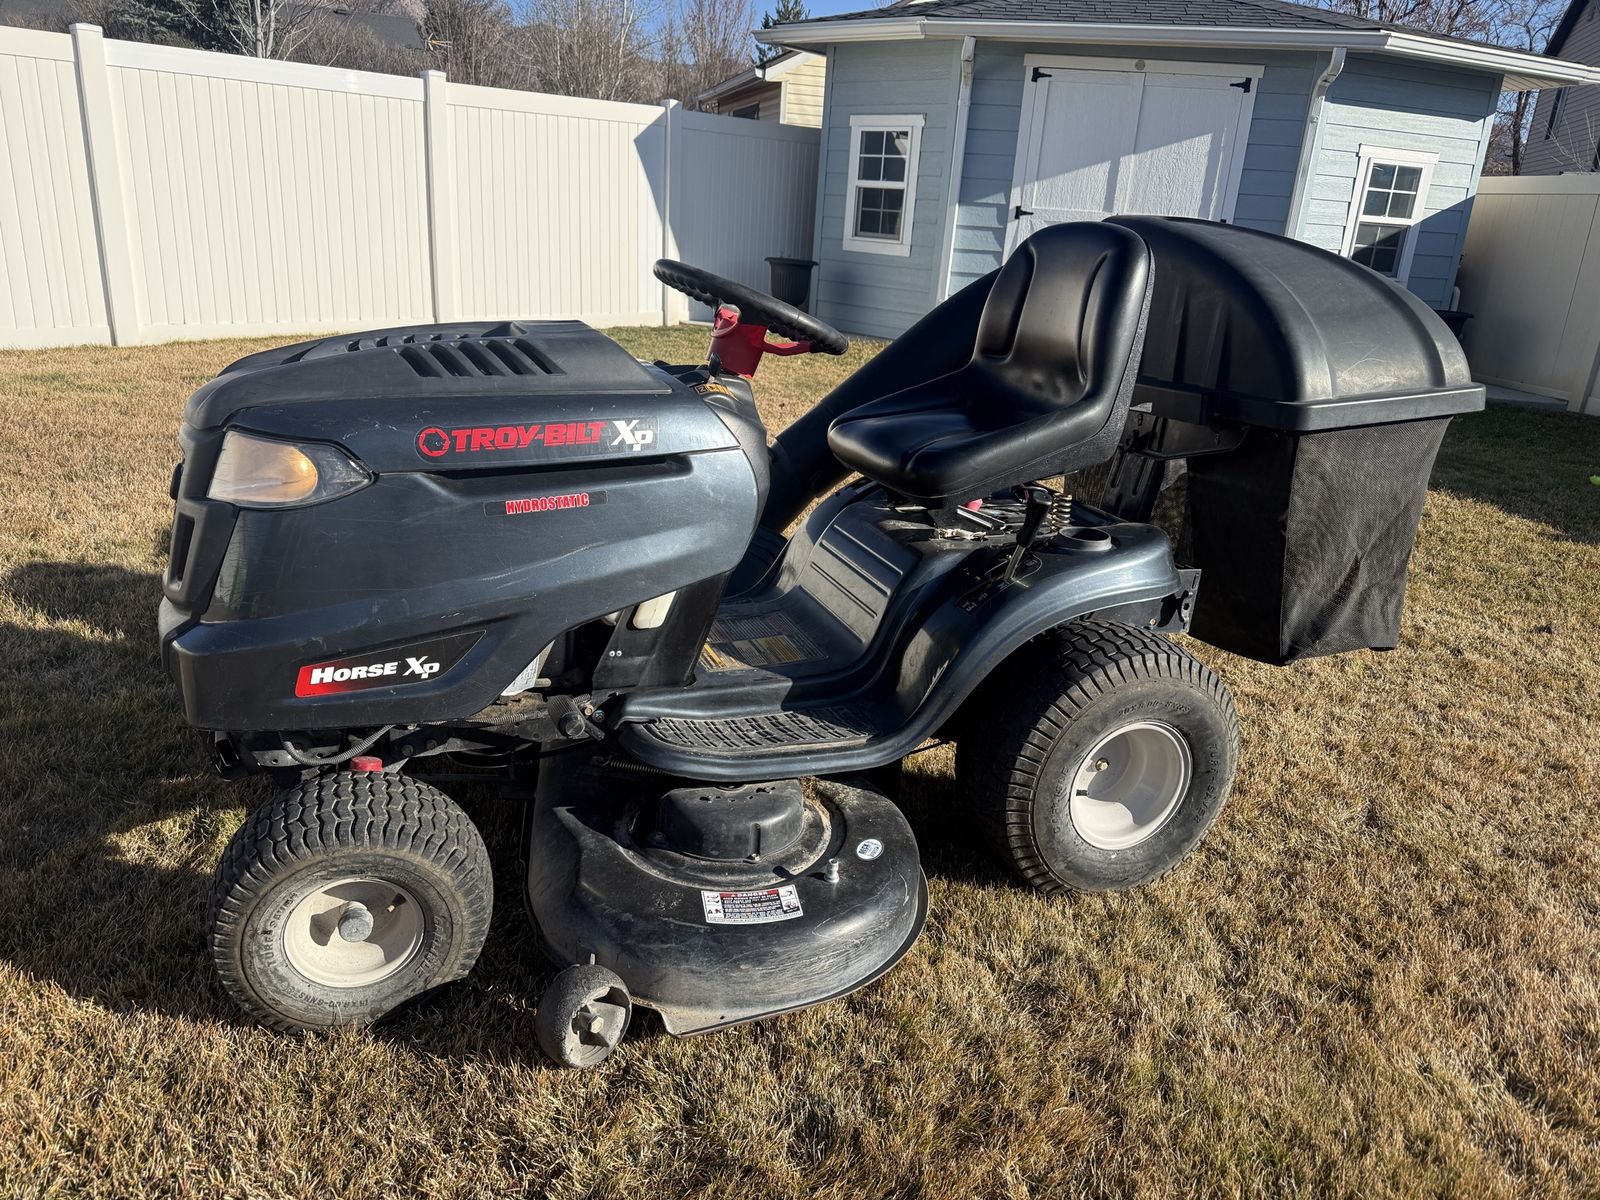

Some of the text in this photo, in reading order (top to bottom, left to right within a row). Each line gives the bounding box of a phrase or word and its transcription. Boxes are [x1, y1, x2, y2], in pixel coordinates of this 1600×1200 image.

[452, 422, 606, 452] TROY-BILT
[505, 492, 589, 515] HYDROSTATIC
[310, 662, 398, 685] HORSE
